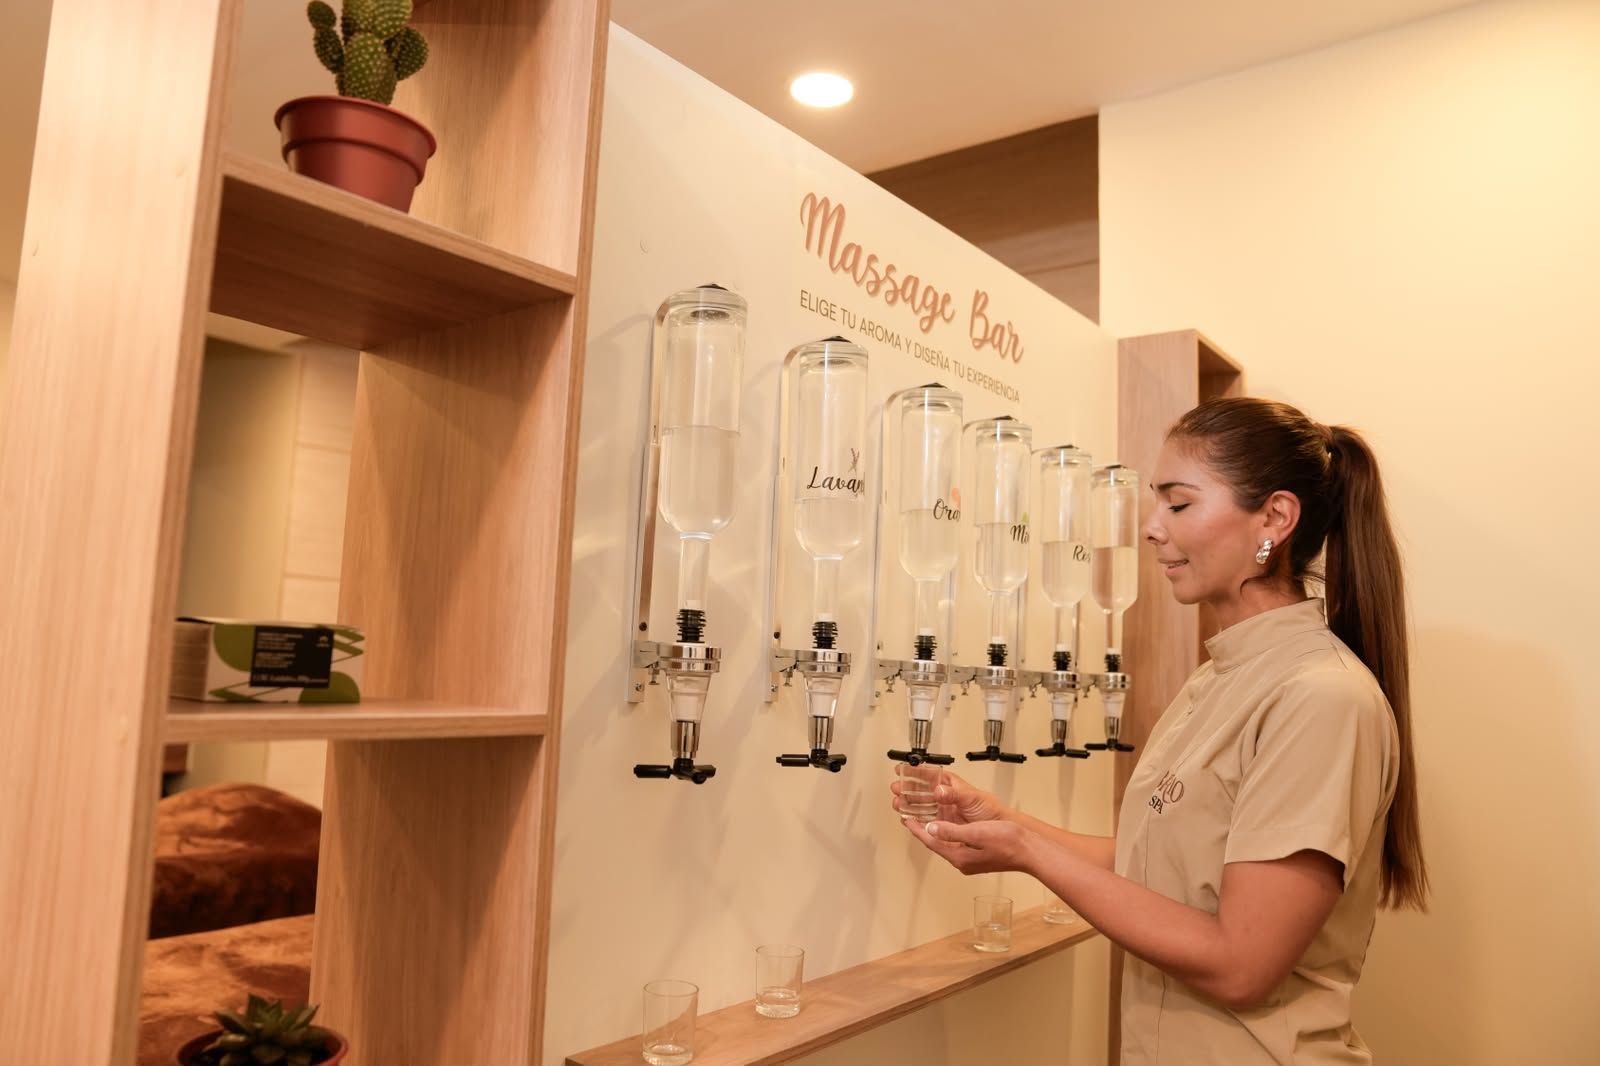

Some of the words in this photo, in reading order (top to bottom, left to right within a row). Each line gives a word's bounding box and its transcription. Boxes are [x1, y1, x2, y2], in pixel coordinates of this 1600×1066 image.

[800, 192, 955, 334] Massage
[969, 289, 1024, 363] Bar
[800, 289, 837, 321] ELIGE
[841, 307, 856, 329] TU
[860, 317, 901, 351] AROMA
[905, 337, 911, 353] Y
[914, 341, 950, 371] DISEÑA
[953, 360, 965, 378] TU
[967, 367, 1020, 402] EXPERIENCIA
[1148, 795, 1164, 815] SPA
